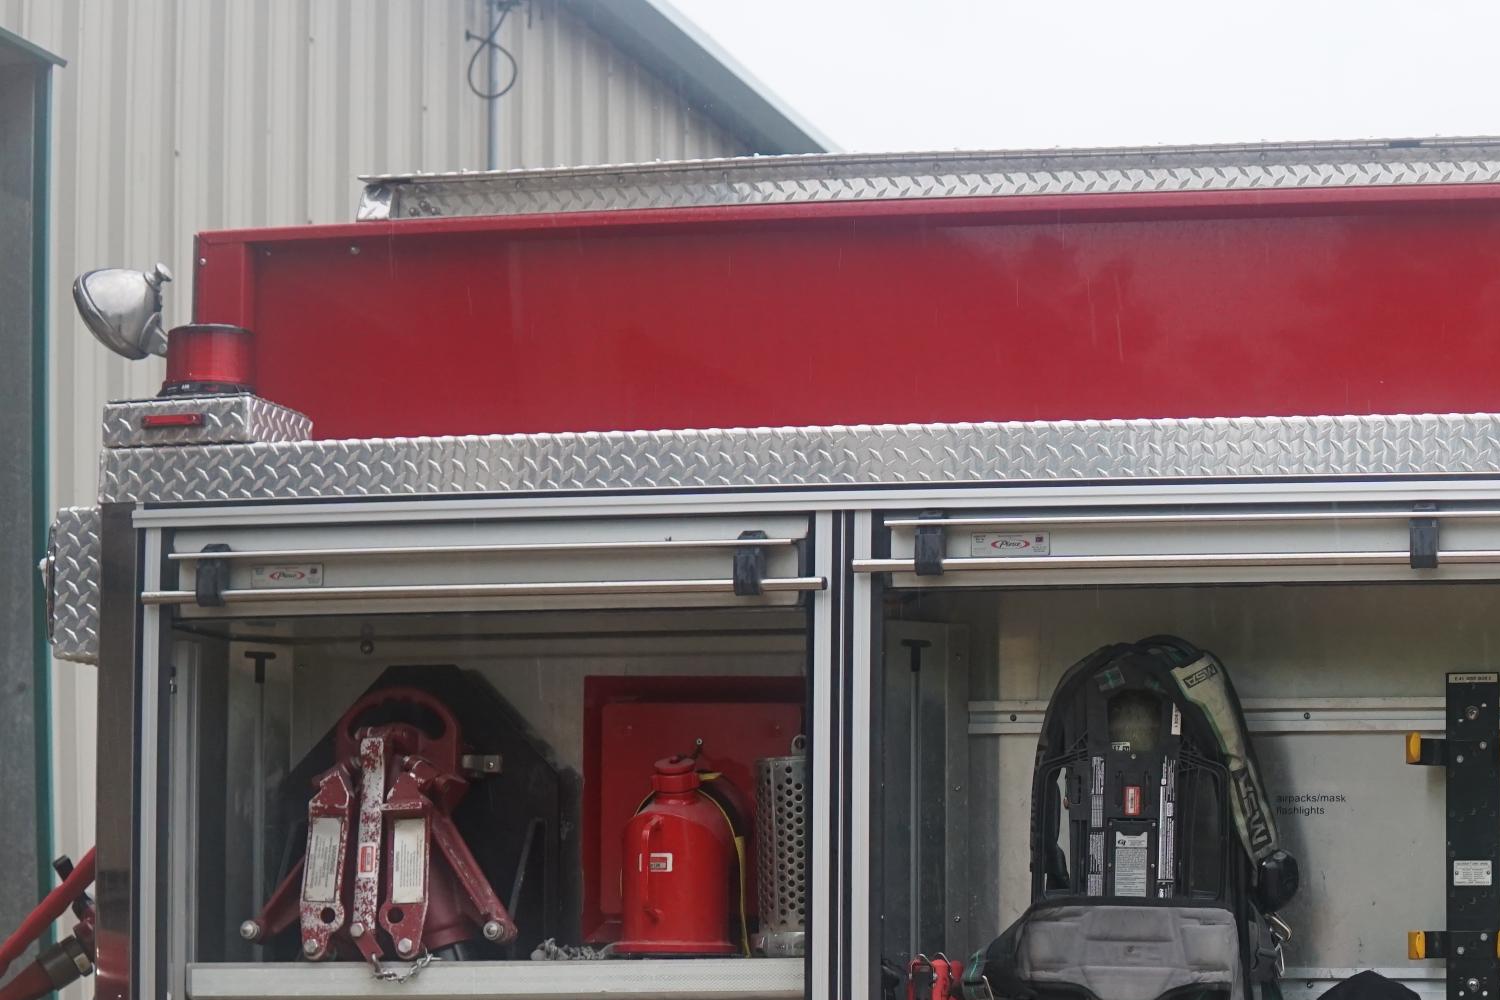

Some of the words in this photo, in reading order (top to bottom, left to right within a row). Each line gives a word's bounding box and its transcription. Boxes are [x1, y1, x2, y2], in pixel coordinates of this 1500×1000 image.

[1184, 664, 1217, 688] MSA
[1276, 793, 1346, 804] airpacks/mask
[1237, 772, 1268, 847] MSA
[1276, 806, 1325, 817] flashlights
